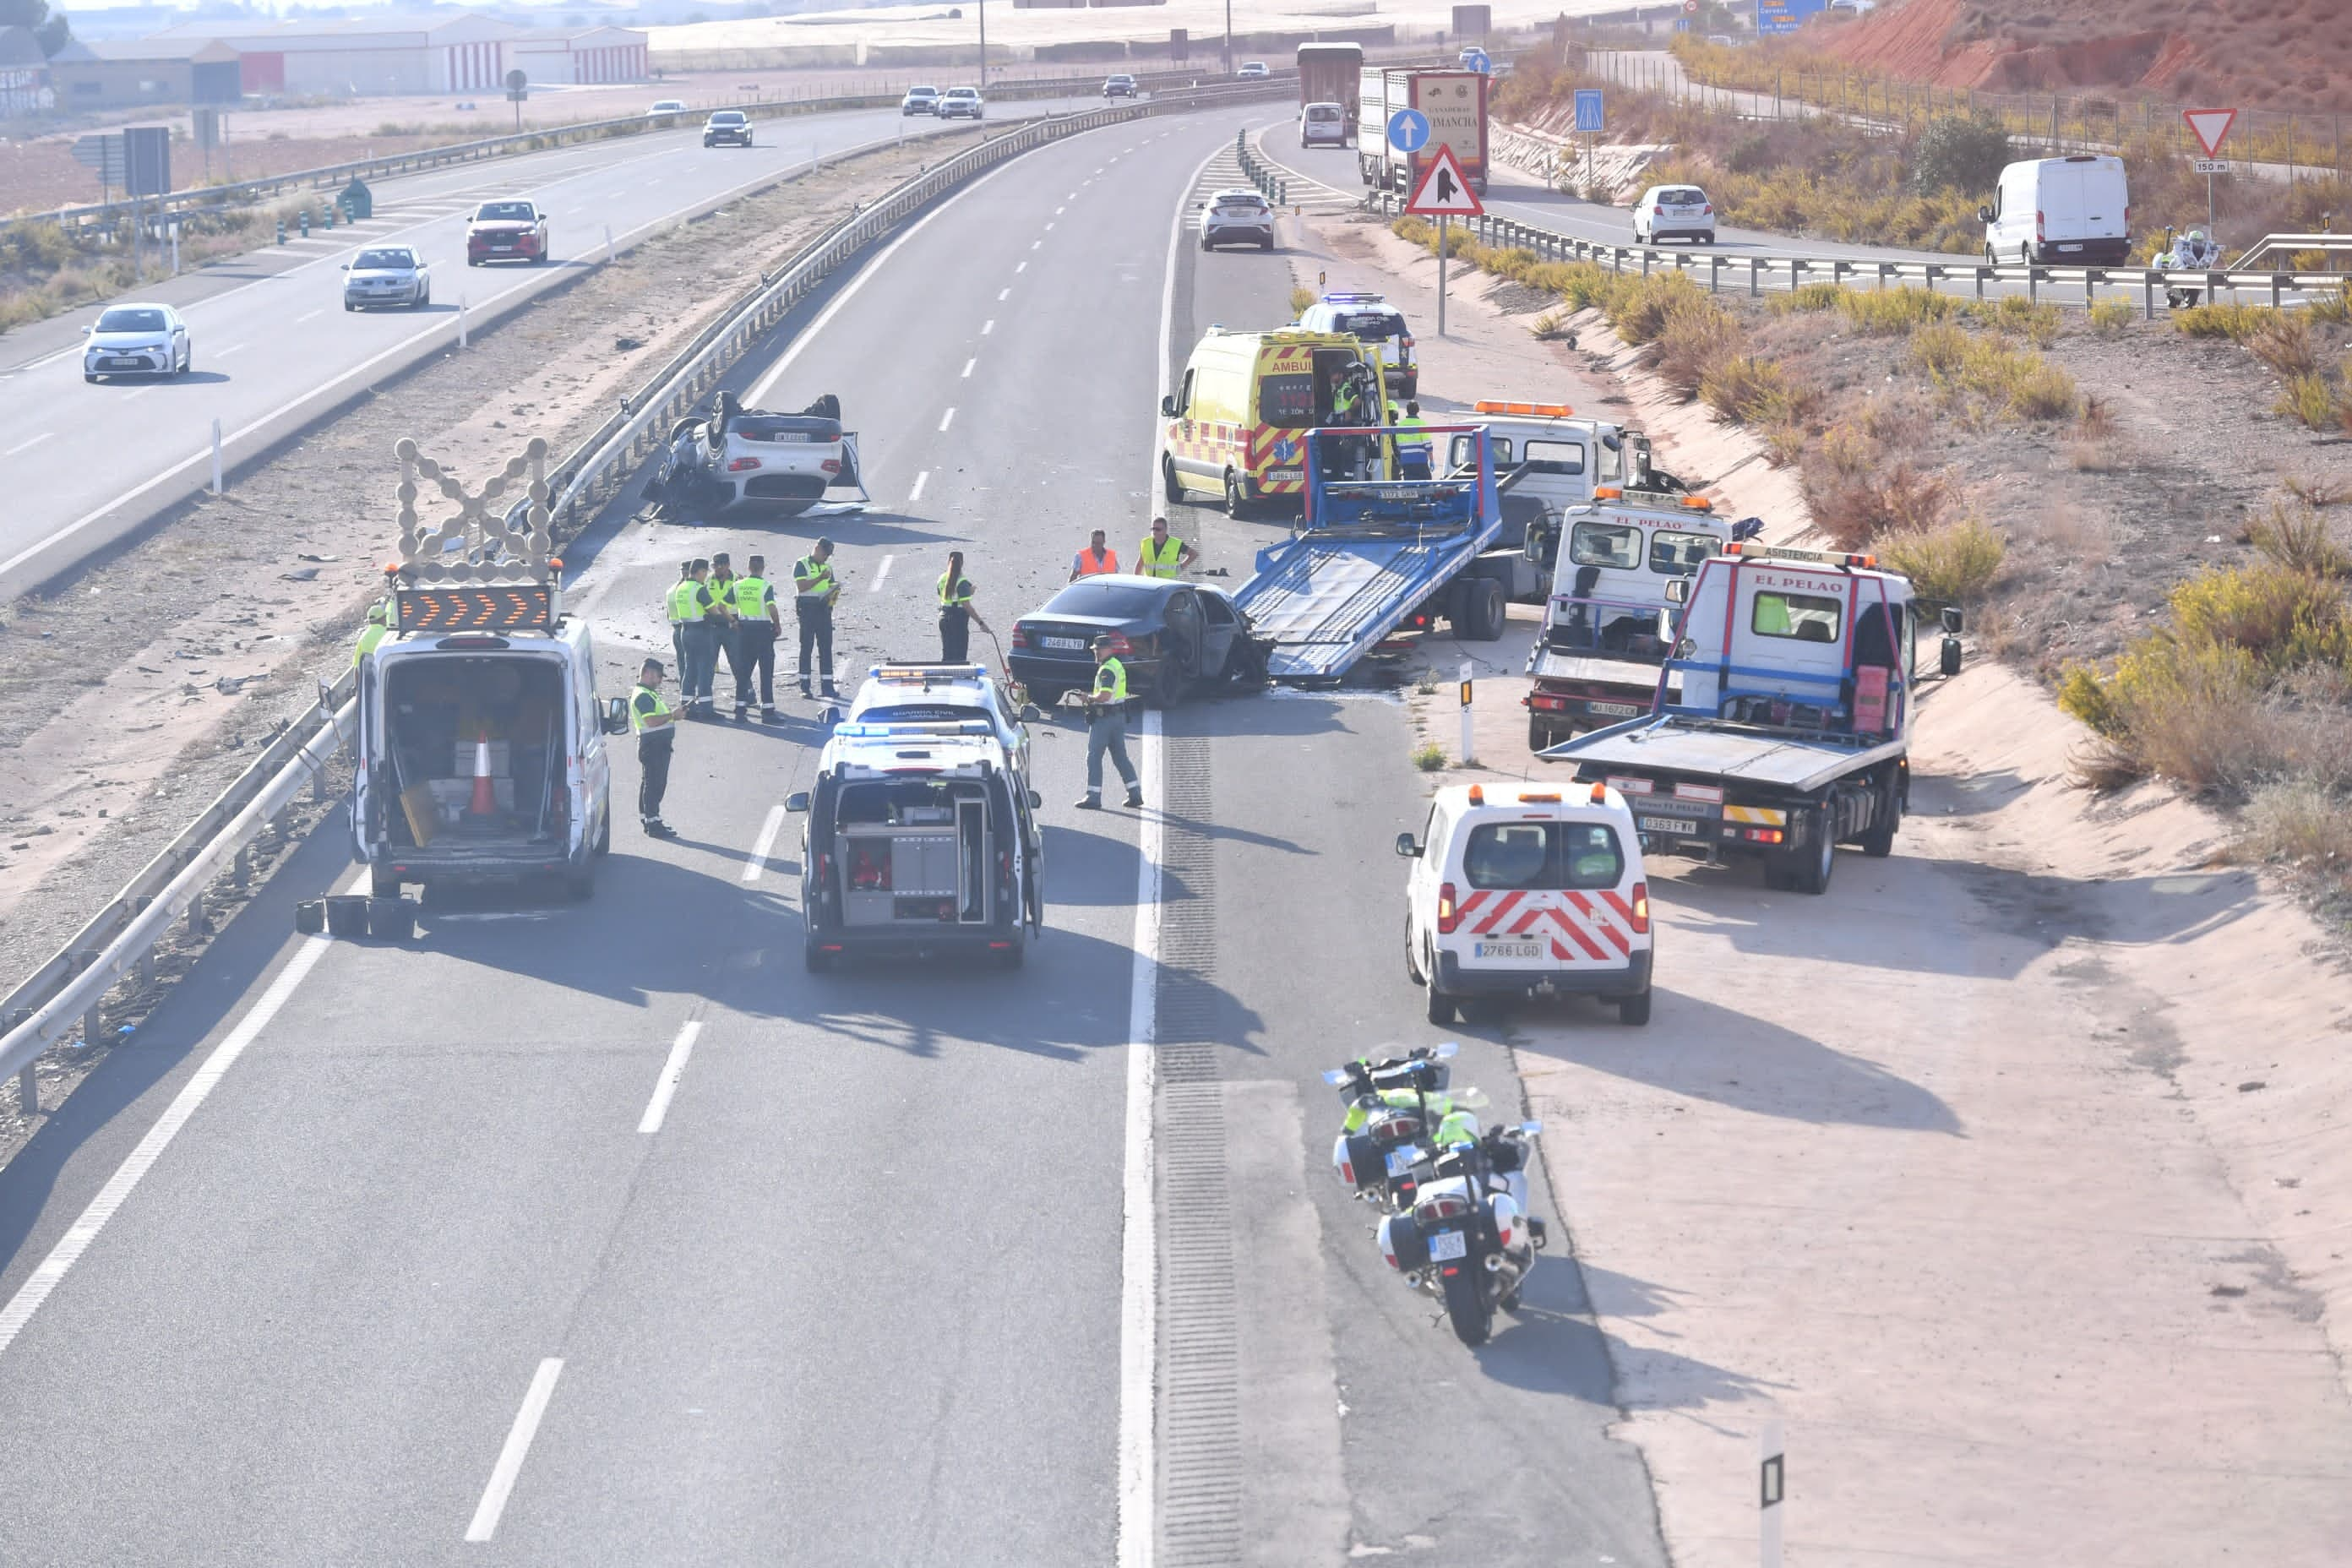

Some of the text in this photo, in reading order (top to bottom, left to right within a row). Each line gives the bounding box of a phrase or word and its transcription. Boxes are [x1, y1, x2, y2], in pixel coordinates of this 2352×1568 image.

[1765, 547, 1823, 562] ASISTENCIA
[1756, 574, 1843, 592] EL PELAO
[1646, 818, 1694, 832] 0363 FWK
[1484, 945, 1512, 957] 2766
